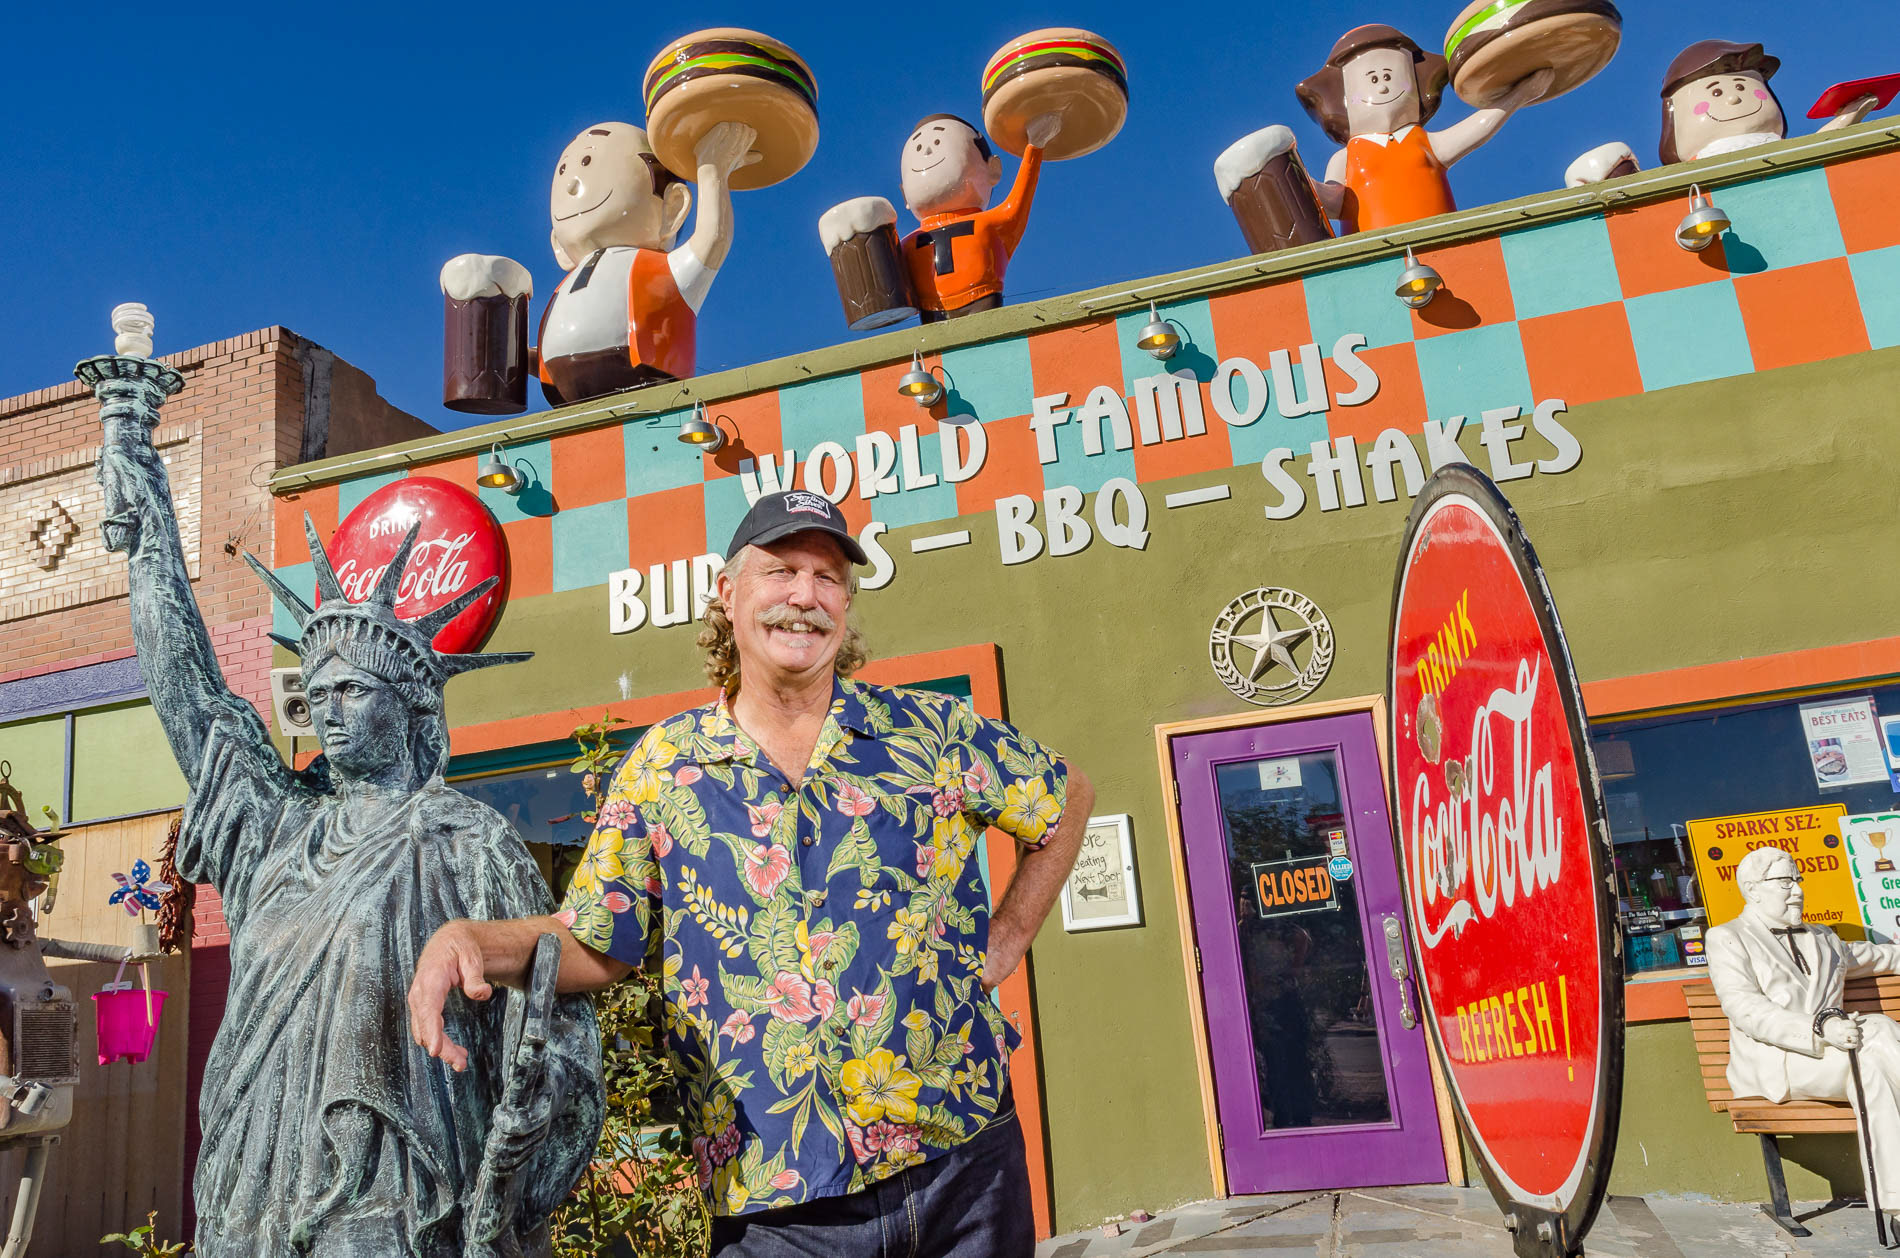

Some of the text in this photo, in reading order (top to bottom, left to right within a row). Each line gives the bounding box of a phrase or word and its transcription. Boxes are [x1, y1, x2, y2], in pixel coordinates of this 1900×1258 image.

[916, 220, 975, 276] T
[738, 333, 1380, 507] WORLD FAMOUS
[369, 512, 421, 539] DRINK
[608, 521, 896, 635] BURS
[995, 476, 1150, 566] BBQ
[1264, 398, 1581, 519] SHAKES
[336, 530, 477, 604] CocaCola
[1210, 588, 1330, 643] WELCOME
[1416, 587, 1478, 698] DRINK
[1811, 711, 1867, 726] BEST EATS
[1715, 814, 1822, 839] SPARKY SEZ:
[1083, 834, 1106, 848] ore
[1796, 854, 1840, 874] OSED
[1097, 872, 1121, 884] Door
[1259, 866, 1331, 907] CLOSED
[1801, 909, 1843, 922] Monday
[1689, 956, 1706, 964] VISA
